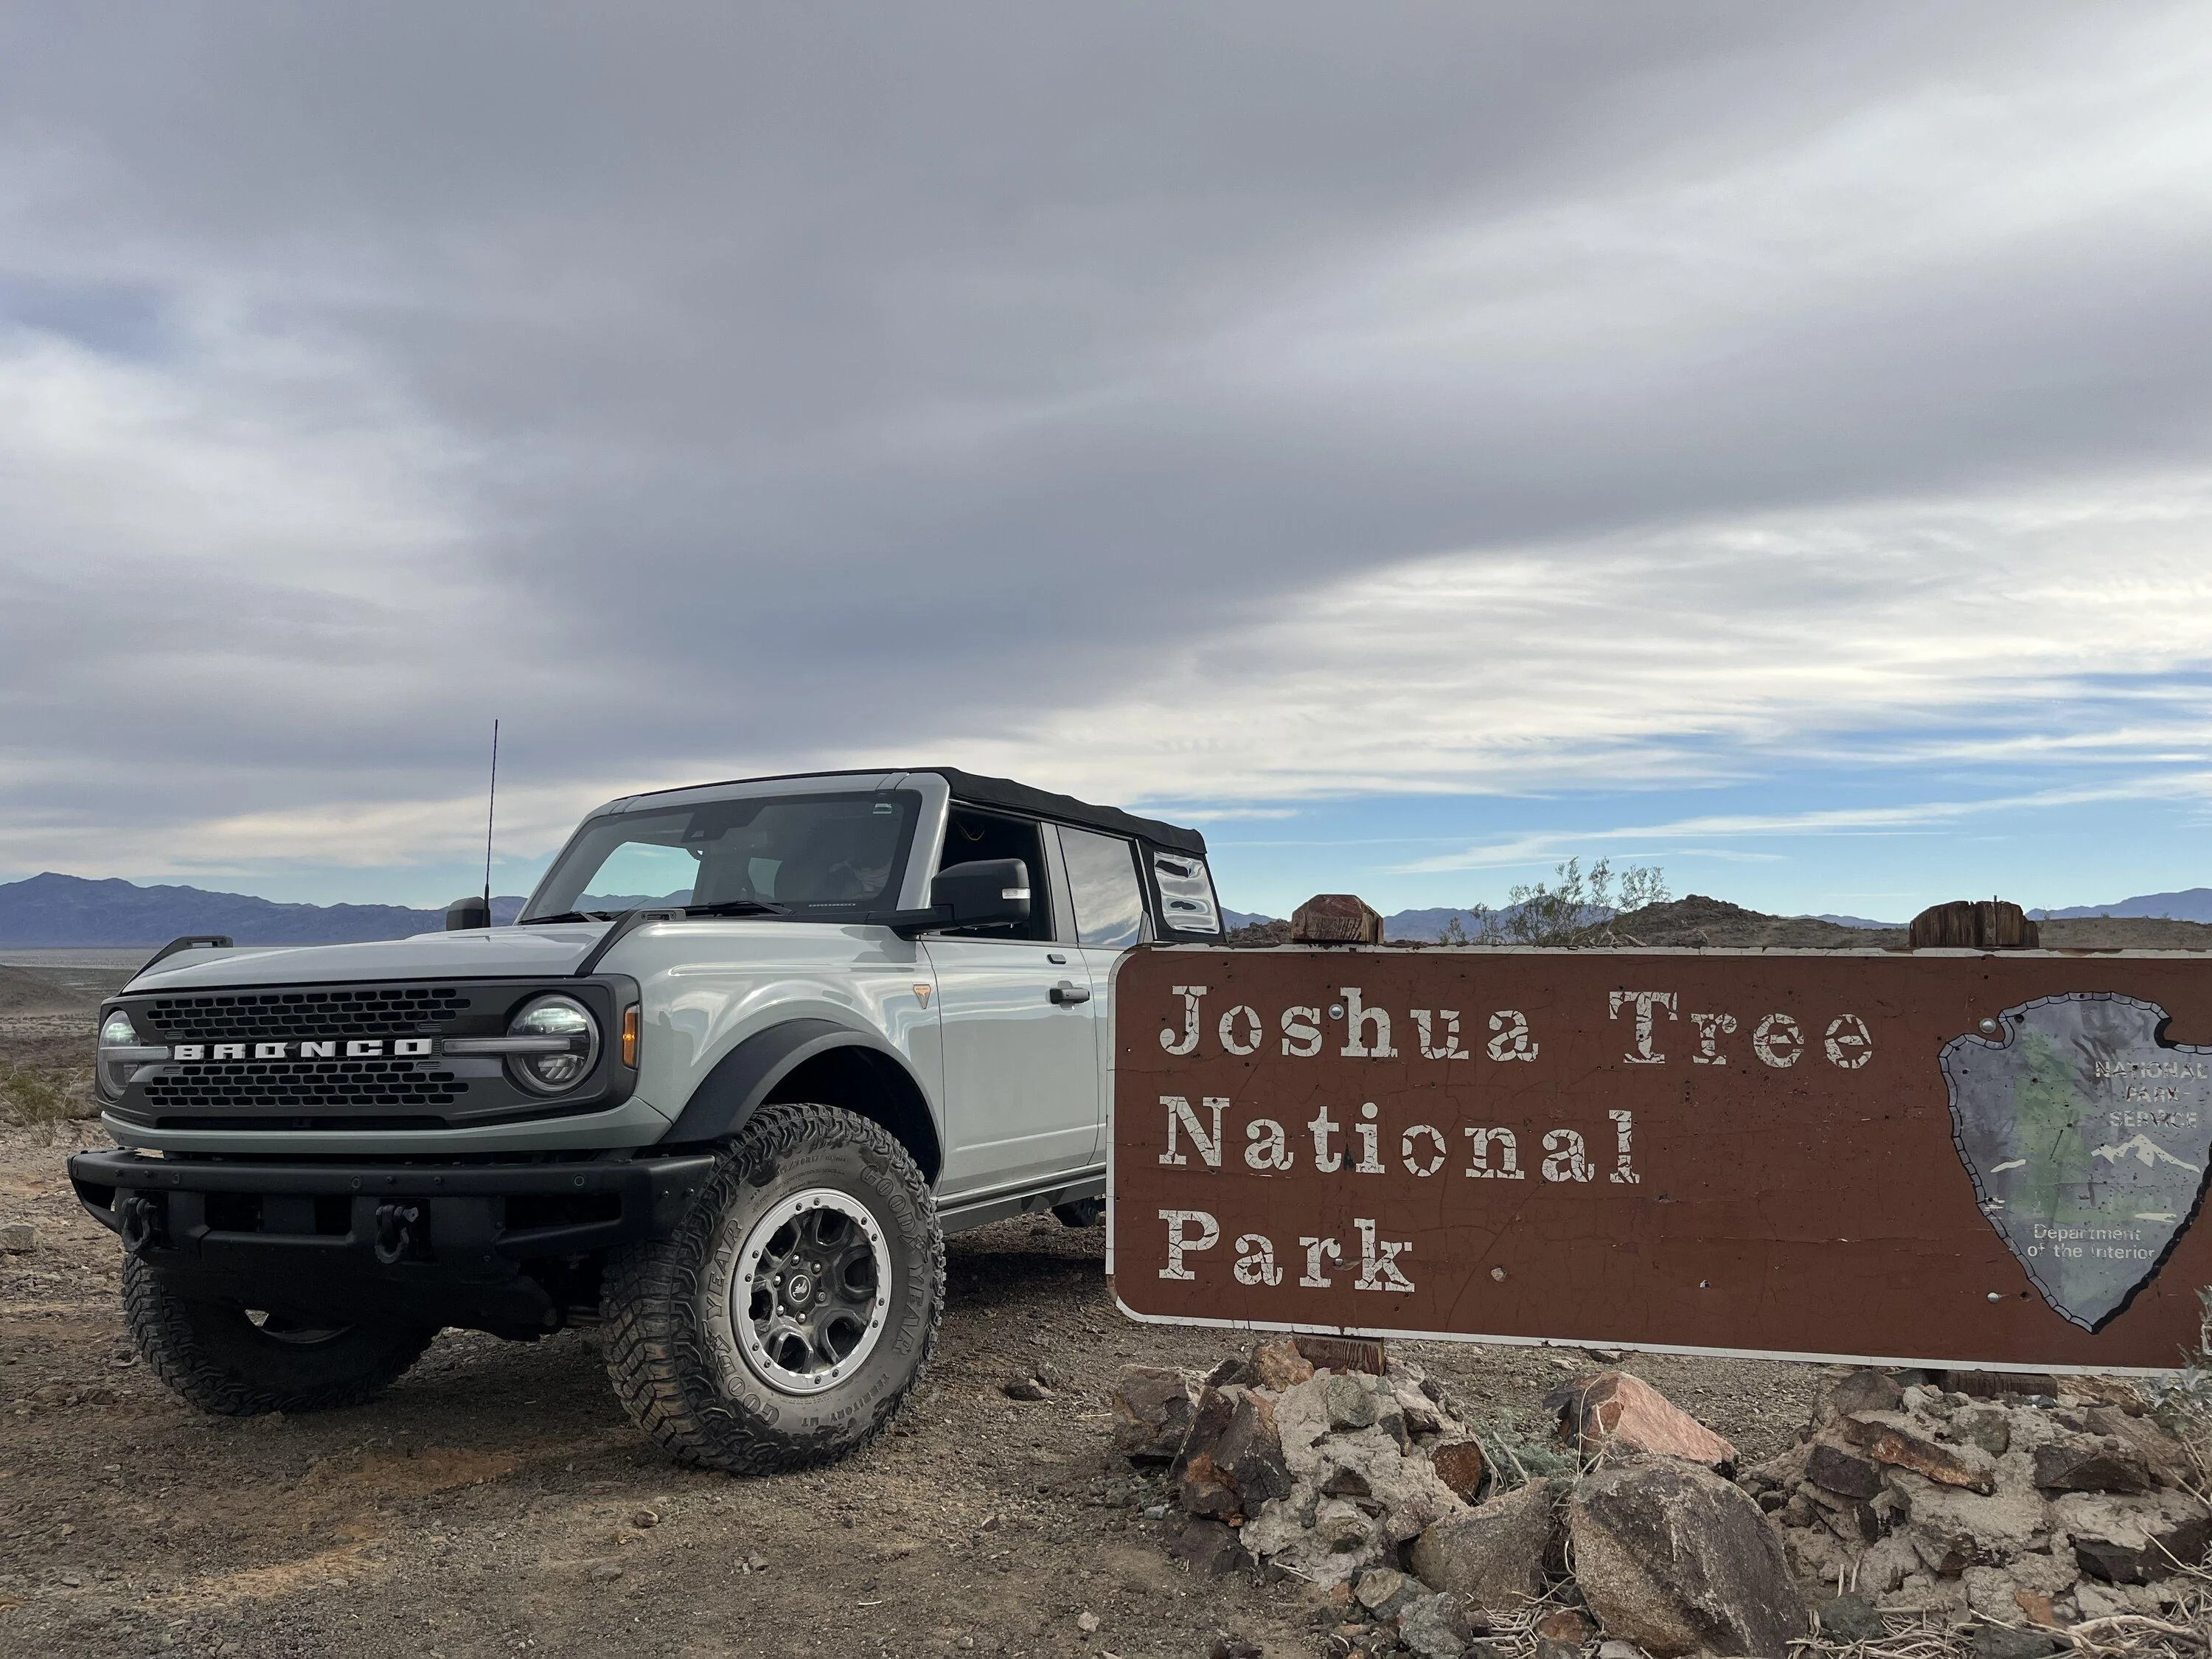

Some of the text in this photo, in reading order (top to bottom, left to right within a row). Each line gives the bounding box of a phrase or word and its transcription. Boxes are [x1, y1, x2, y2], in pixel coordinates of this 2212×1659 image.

[1159, 985, 1873, 1069] Joshua Tree
[174, 1038, 432, 1060] BRONCO
[2096, 1061, 2208, 1079] NATIONAL
[2126, 1085, 2180, 1103] PARK
[2110, 1109, 2197, 1129] SERVICE
[1158, 1096, 1641, 1185] National
[2034, 1223, 2142, 1242] Department
[860, 1164, 925, 1356] GOODYEAR
[1158, 1209, 1416, 1293] Park
[2027, 1242, 2155, 1260] of the Interior
[706, 1220, 779, 1426] GOODYEAR
[830, 1373, 890, 1422] TERRITORY
